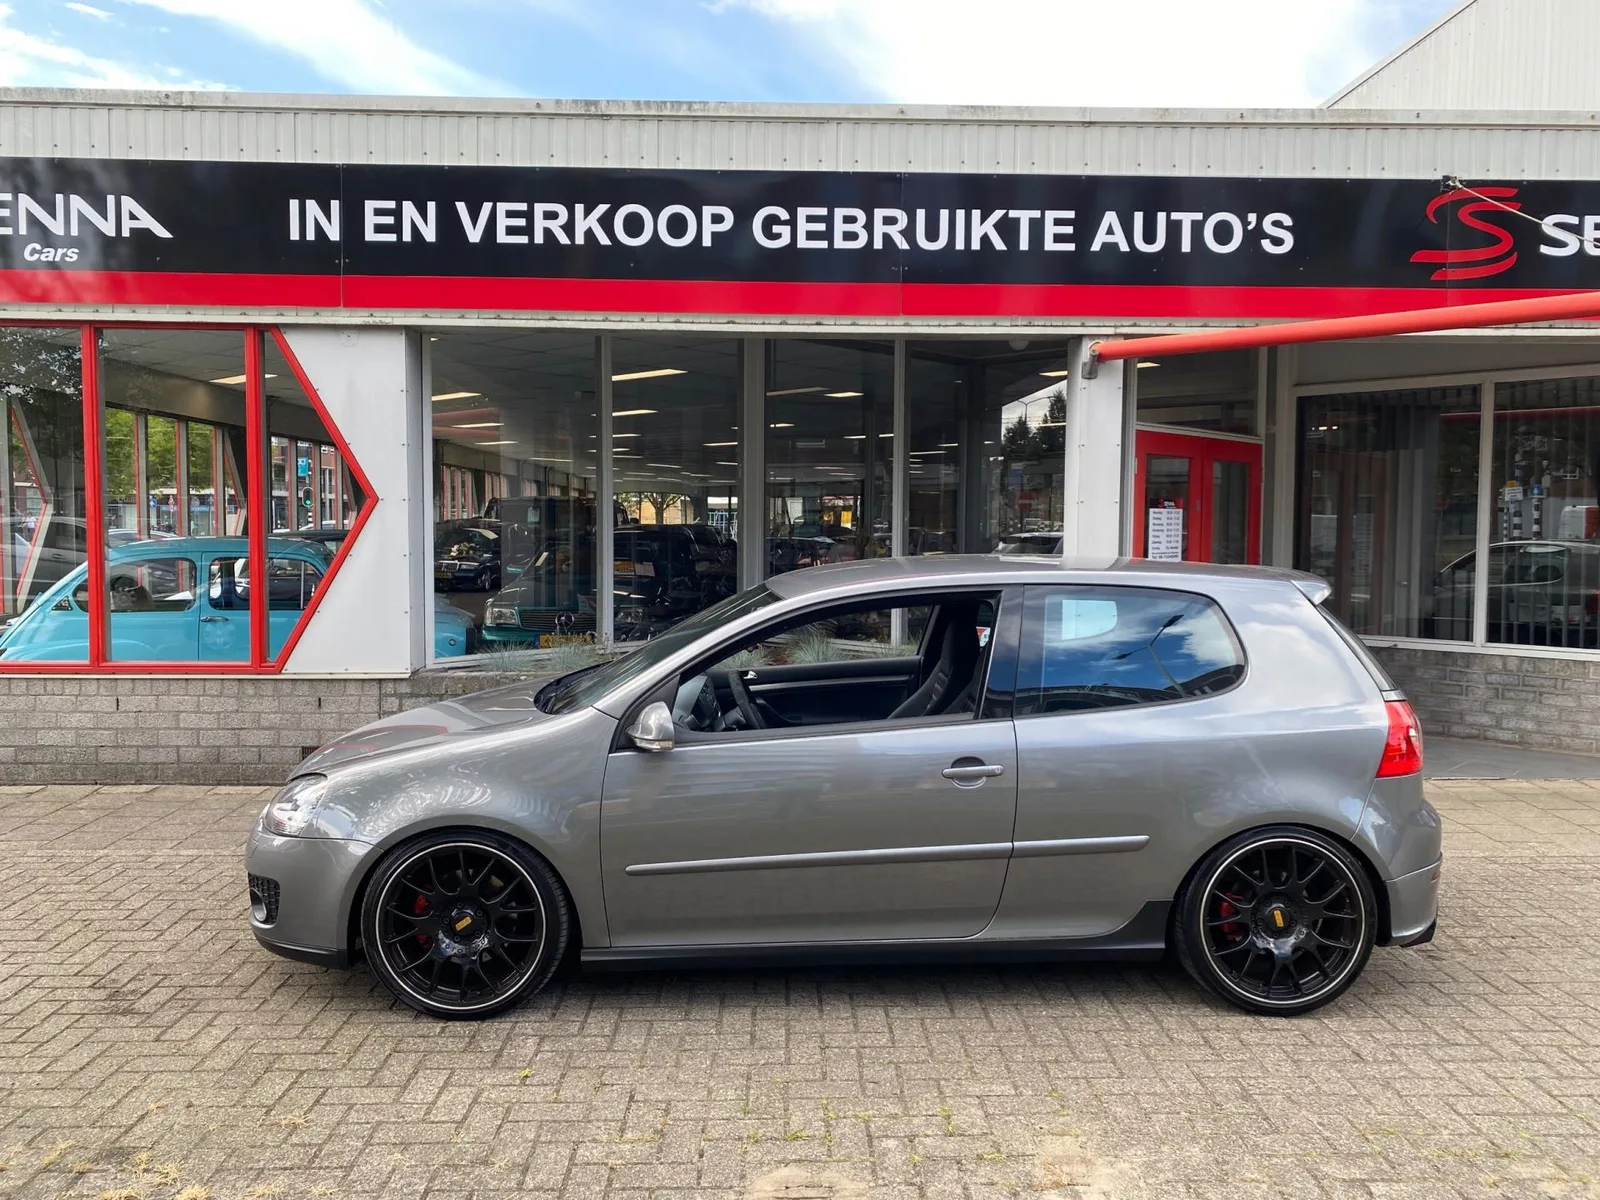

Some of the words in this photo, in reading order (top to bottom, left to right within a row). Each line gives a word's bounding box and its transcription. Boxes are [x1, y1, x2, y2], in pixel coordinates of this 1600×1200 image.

[289, 198, 340, 242] IN
[364, 200, 437, 243] EN
[454, 201, 735, 249] VERKOOP
[752, 205, 1077, 252] GEBRUIKTE
[1090, 210, 1295, 254] AUTO’S
[23, 242, 80, 262] Cars
